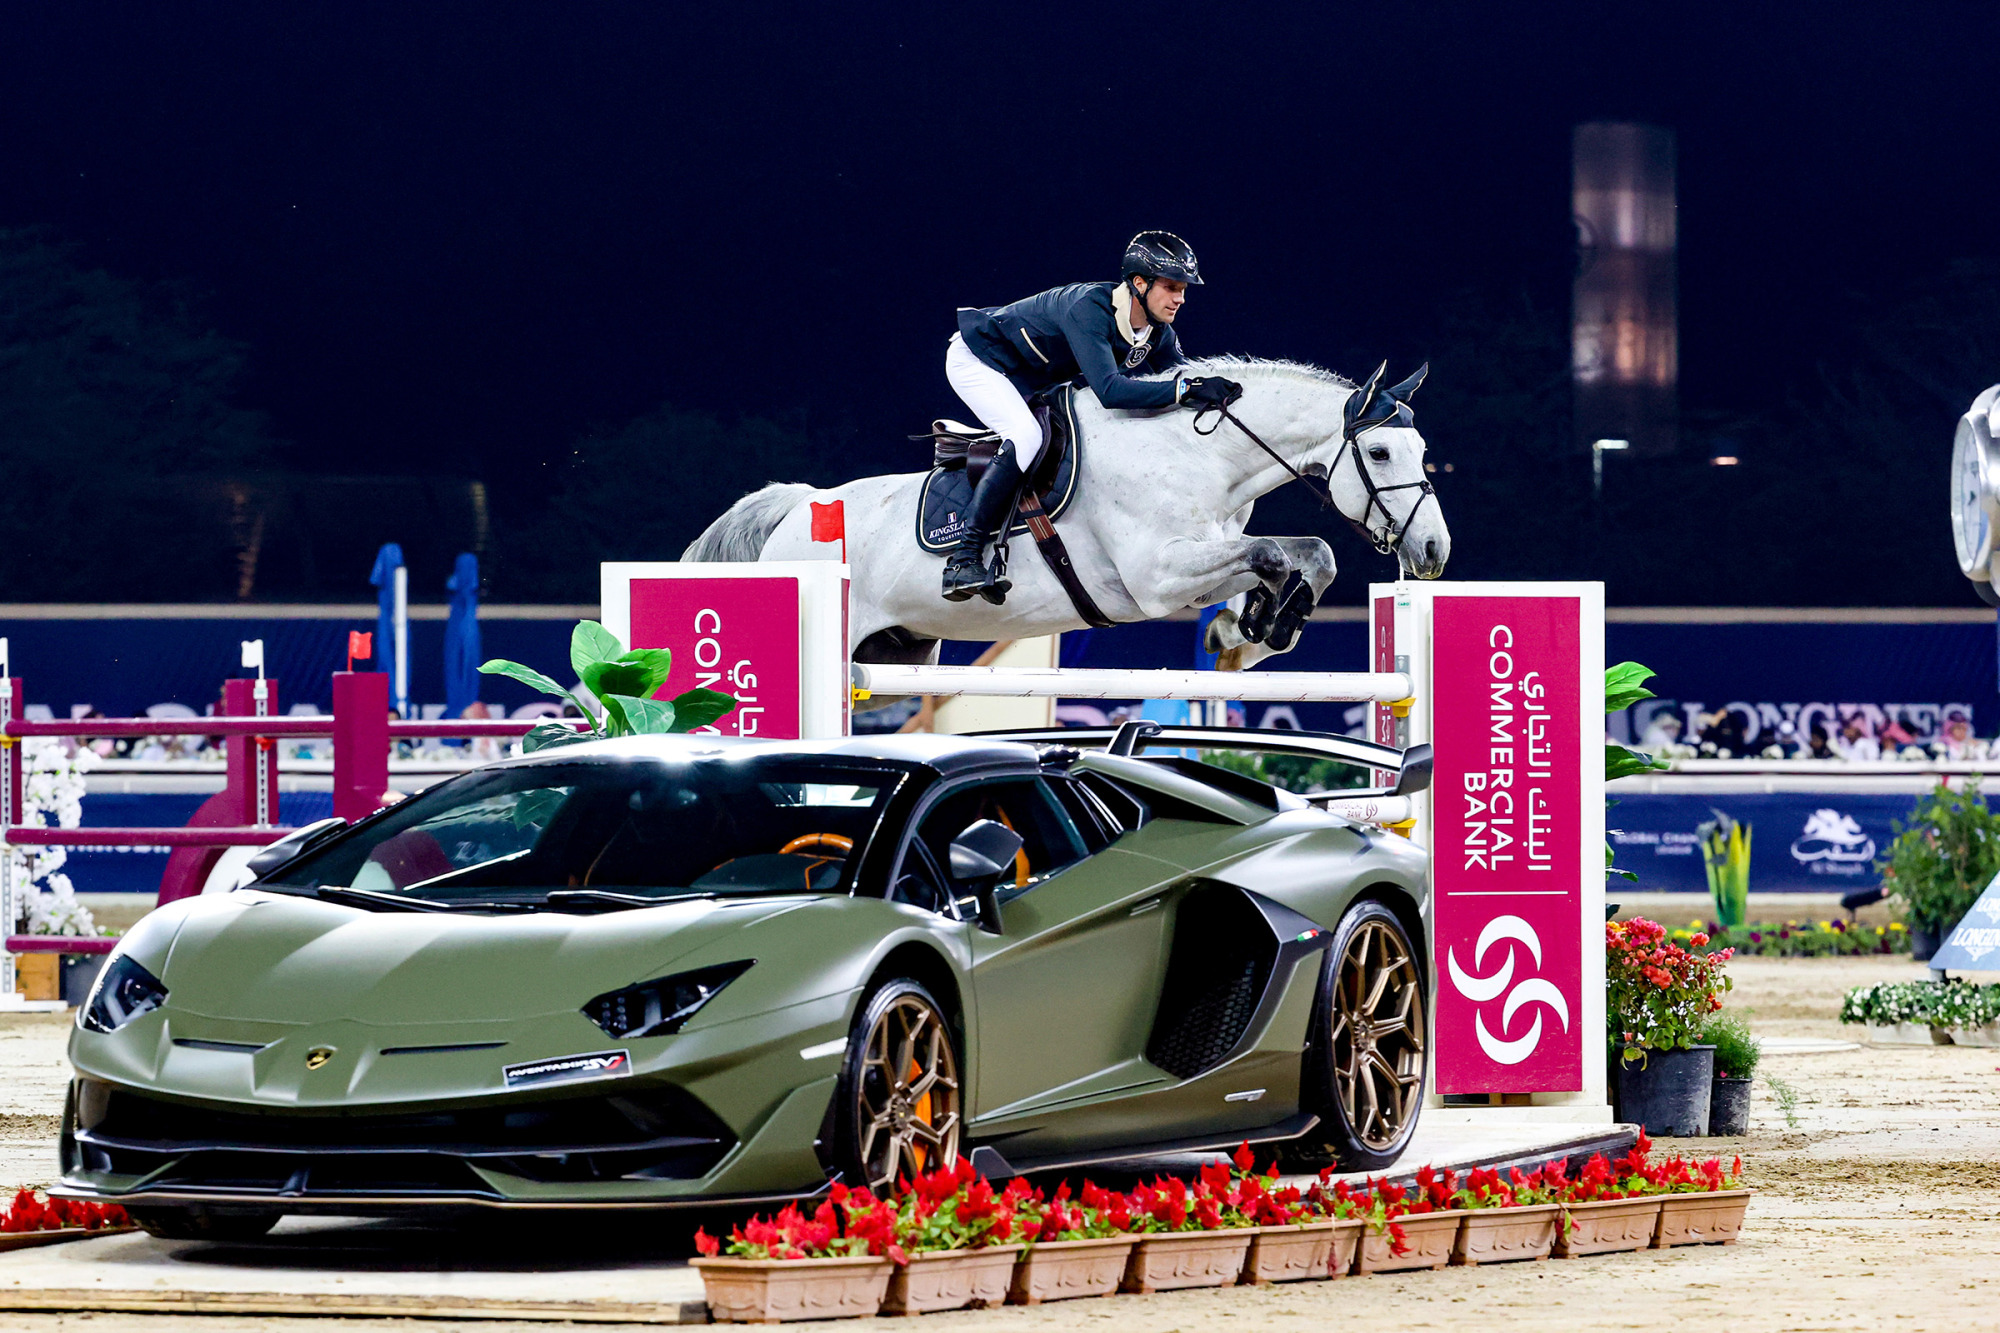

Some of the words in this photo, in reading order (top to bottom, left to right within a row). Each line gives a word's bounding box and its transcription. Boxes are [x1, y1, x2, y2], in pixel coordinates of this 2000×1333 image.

[928, 519, 968, 540] KINGSLA
[1489, 624, 1514, 871] COMMERCIAL
[1518, 671, 1551, 777] التجاري
[1463, 772, 1488, 871] BANK
[1521, 787, 1552, 871] البنك
